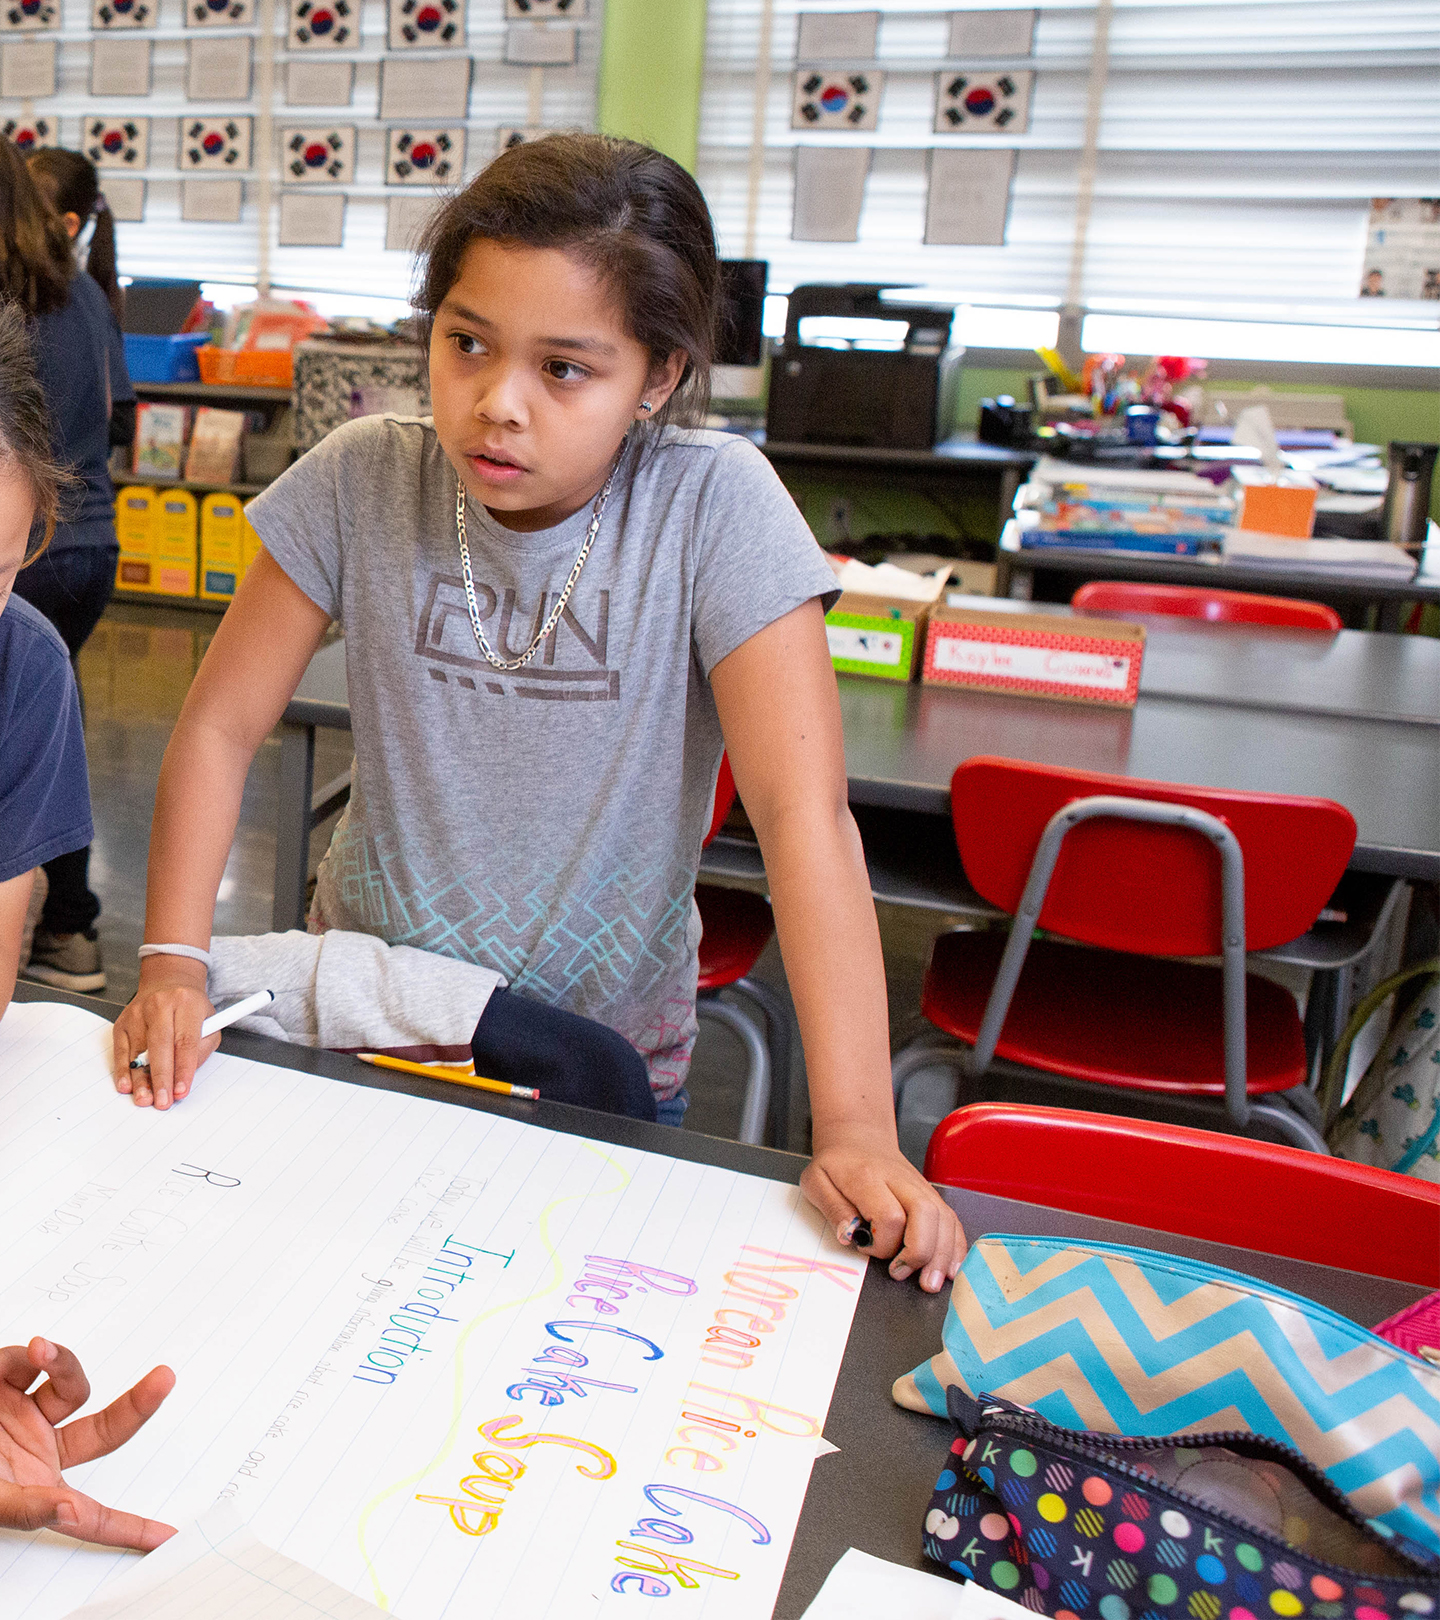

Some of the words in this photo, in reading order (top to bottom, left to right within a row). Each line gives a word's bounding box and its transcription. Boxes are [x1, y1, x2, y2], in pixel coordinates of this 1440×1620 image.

[101, 1209, 187, 1251] Cake
[34, 1261, 127, 1302] Soup
[352, 1233, 515, 1385] Introduction
[357, 1273, 396, 1303] giving
[566, 1254, 699, 1316] Rice
[699, 1245, 860, 1370] Korean
[506, 1319, 665, 1407] Cake
[664, 1381, 823, 1473] Rice
[415, 1414, 618, 1537] Soup
[611, 1483, 772, 1597] Cake
